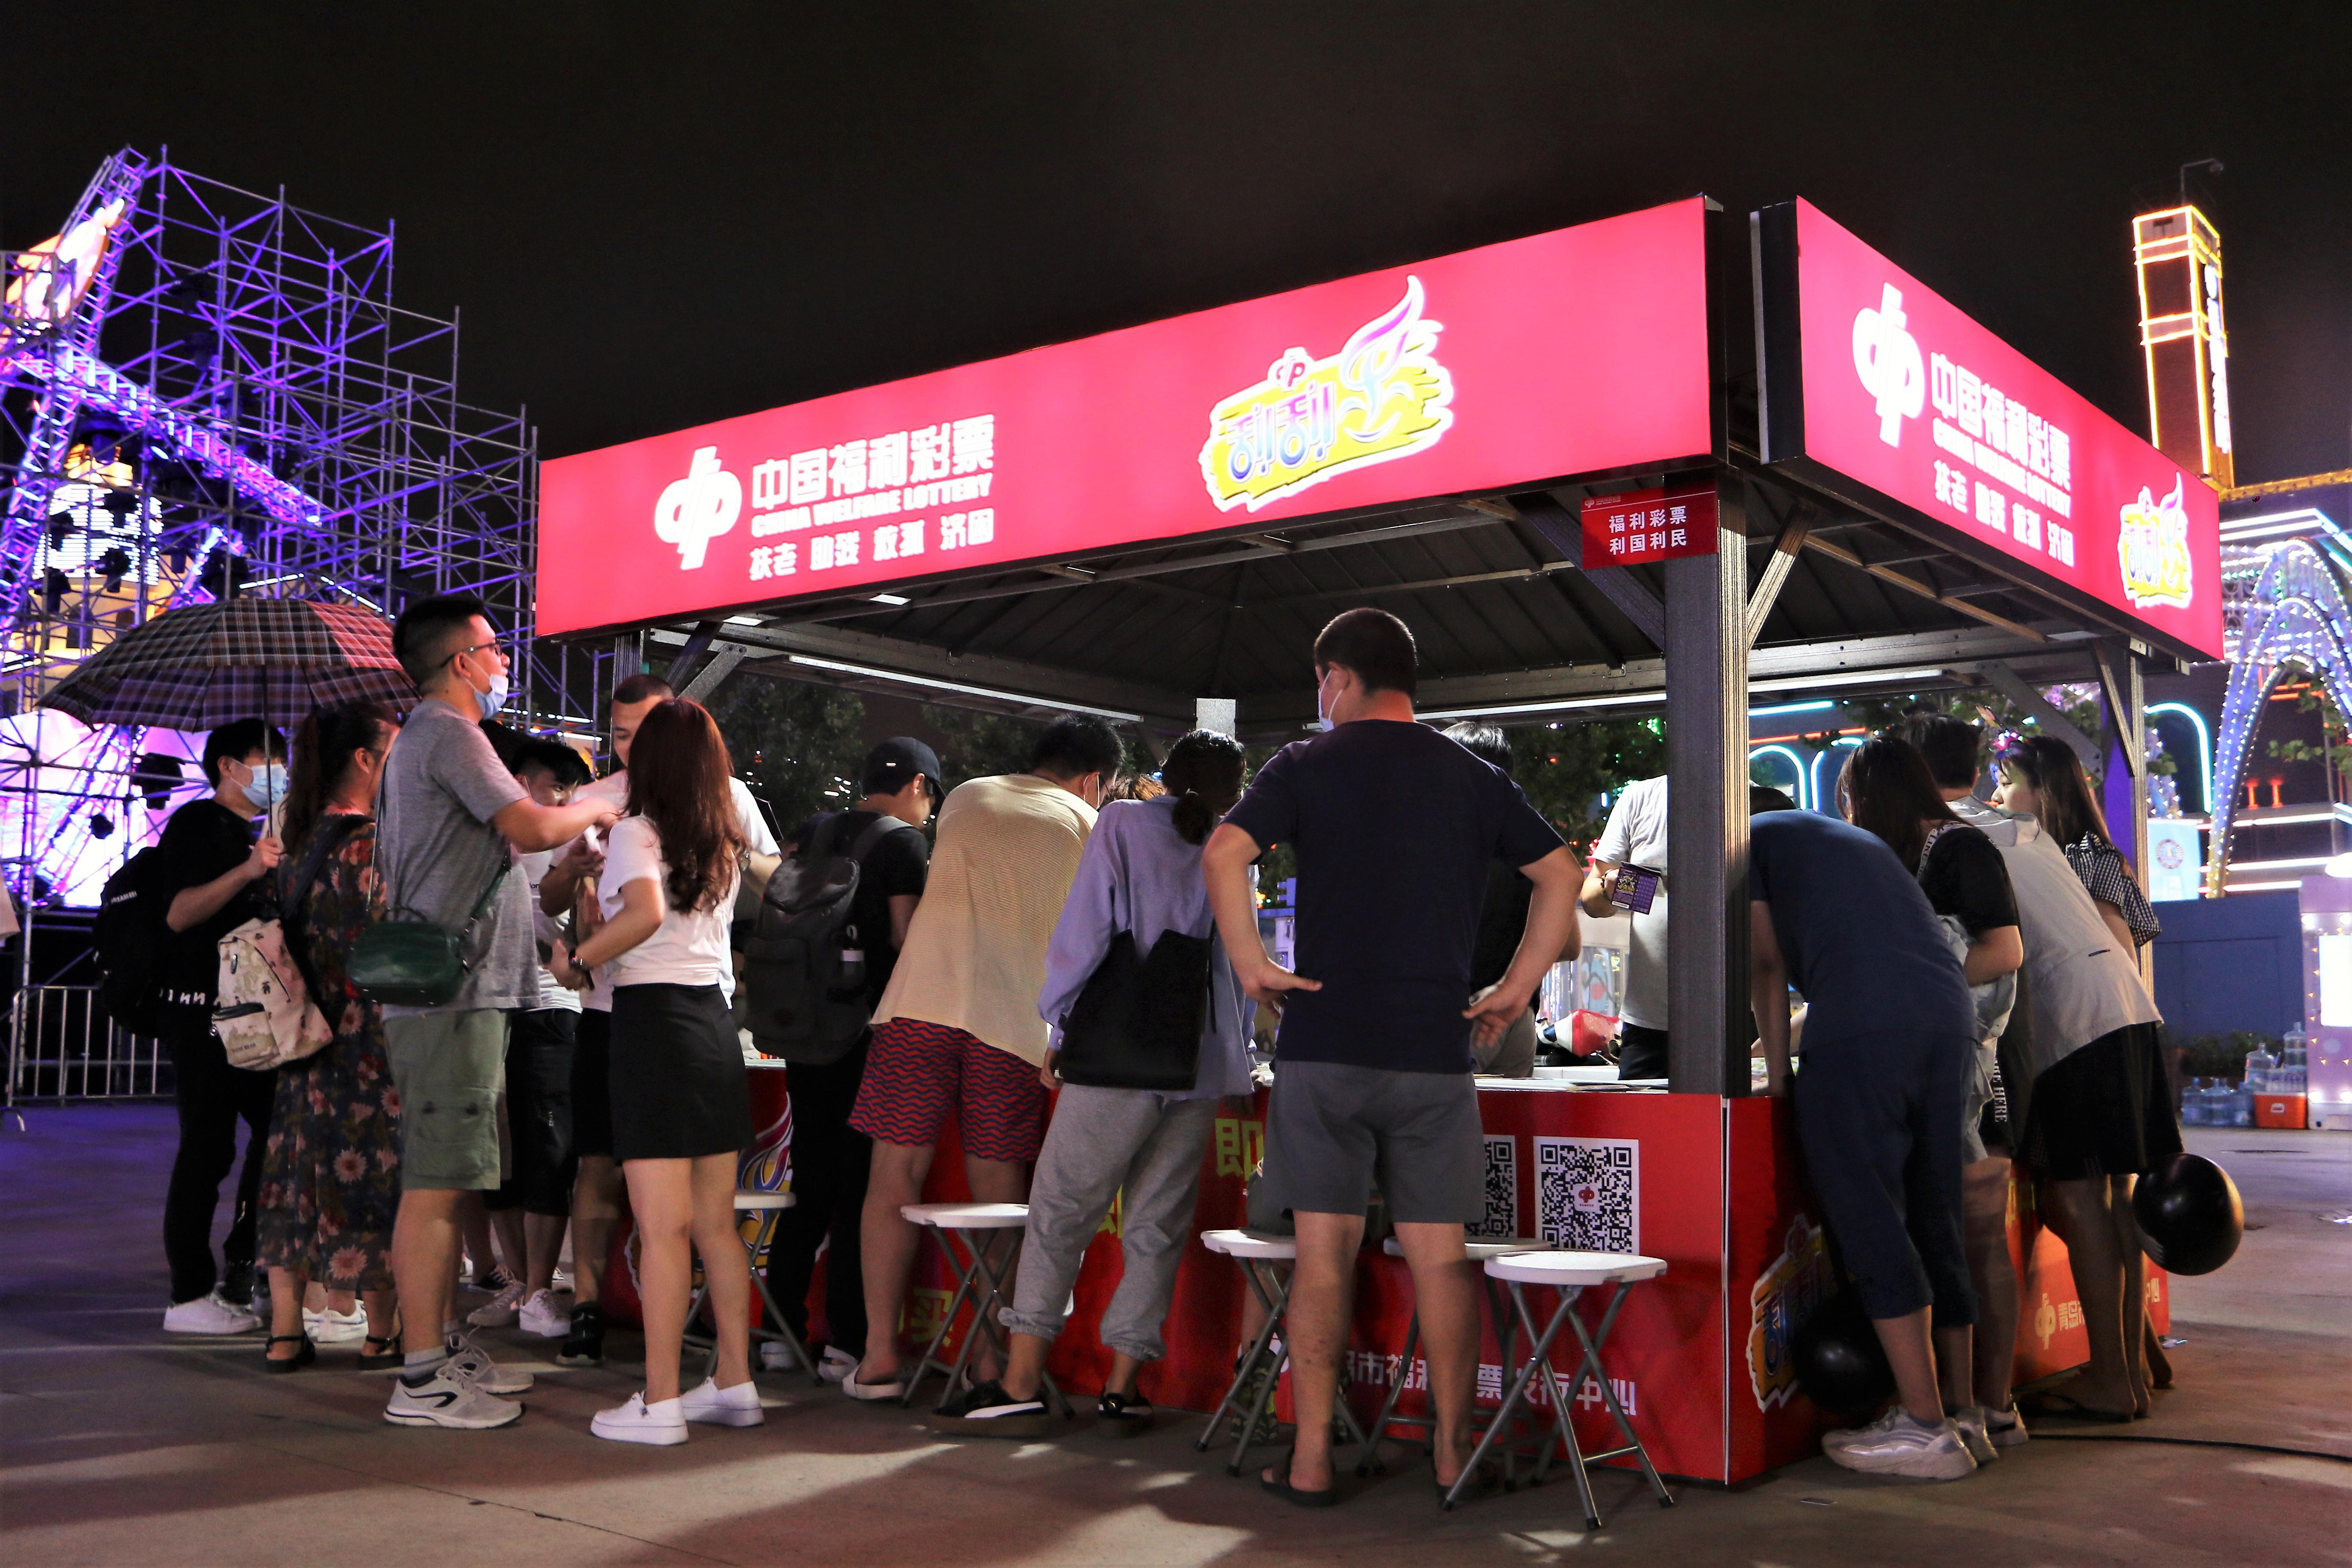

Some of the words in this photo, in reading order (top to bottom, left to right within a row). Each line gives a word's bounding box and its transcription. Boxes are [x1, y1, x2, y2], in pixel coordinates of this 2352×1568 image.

[1930, 352, 2071, 491] 中国福利彩票
[751, 414, 995, 511] 中国福利彩票
[751, 506, 812, 538] CHINA
[812, 489, 902, 526] WELFARE
[903, 472, 993, 511] LOTTERY
[1608, 505, 1687, 534] 福利彩票
[749, 542, 797, 581] 扶老
[940, 508, 995, 551] 济困
[1609, 528, 1687, 556] 利国利民
